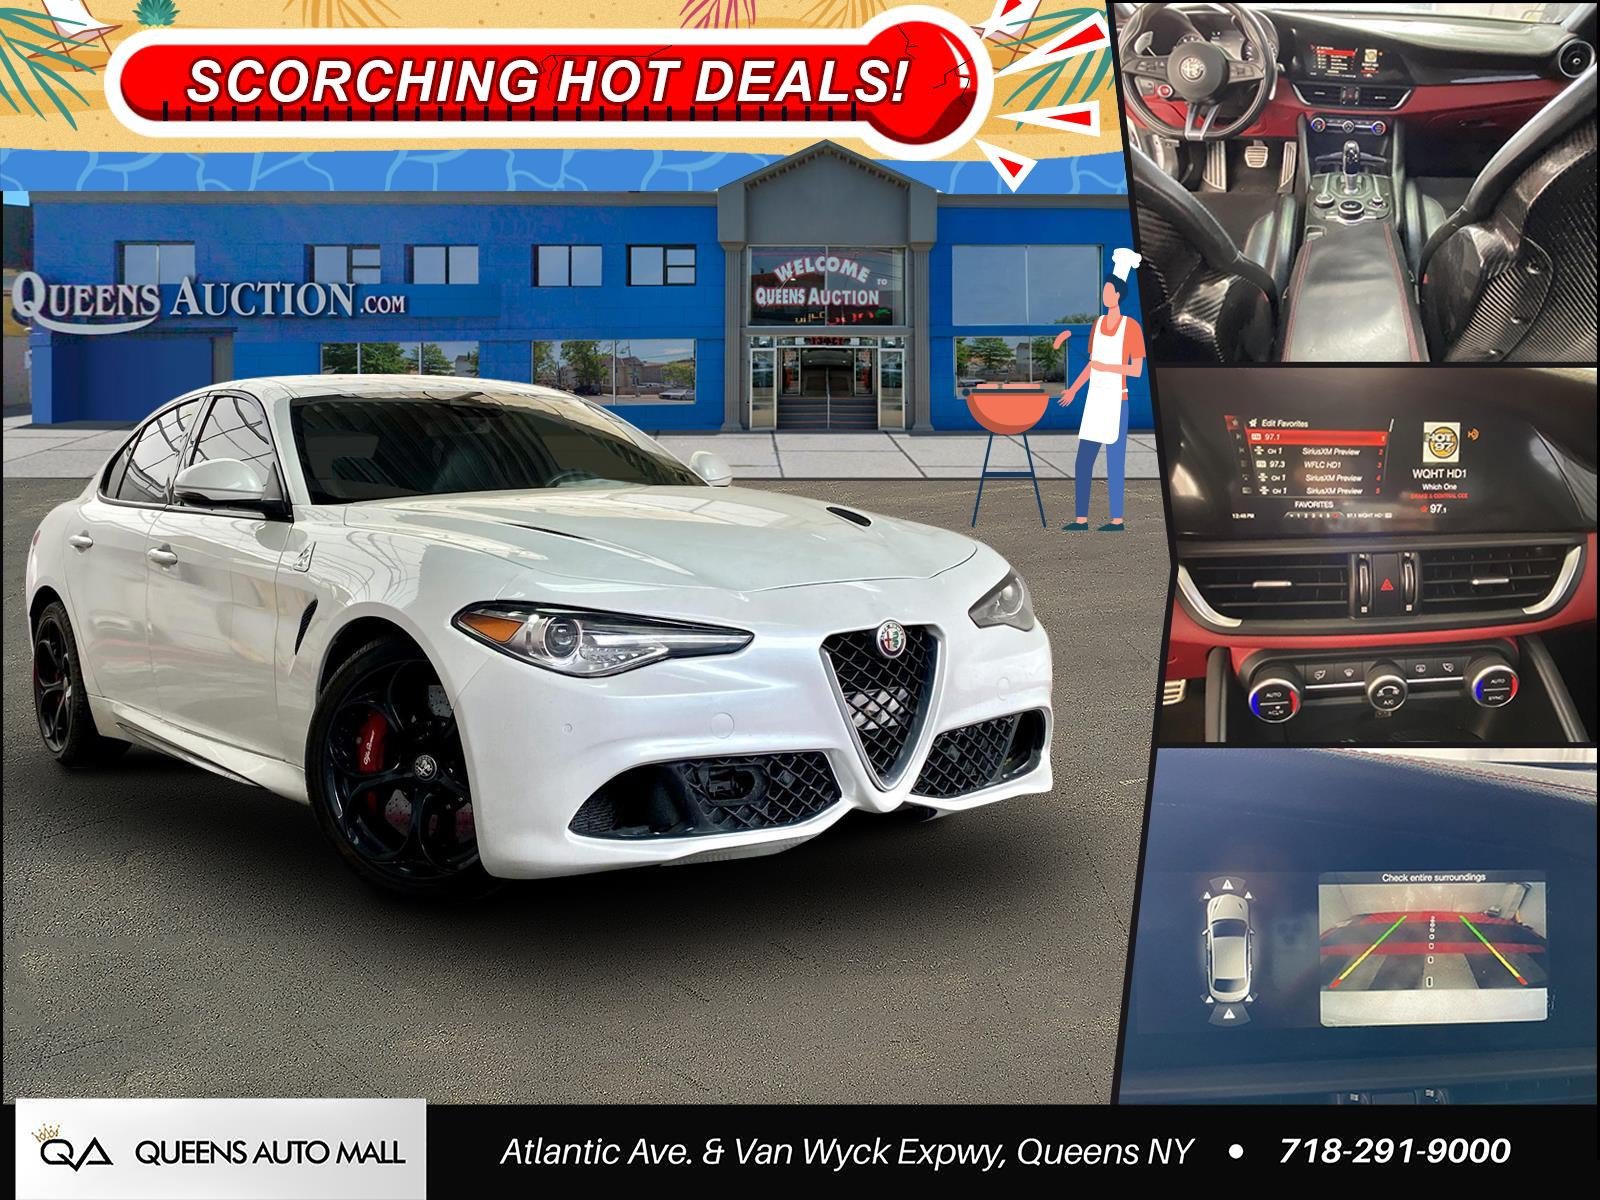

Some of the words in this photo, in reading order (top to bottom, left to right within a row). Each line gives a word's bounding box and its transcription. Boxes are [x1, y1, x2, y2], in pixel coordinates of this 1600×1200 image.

[774, 255, 872, 285] WELCOME
[755, 287, 806, 306] QUEENS
[807, 287, 880, 306] AUCTION
[12, 271, 161, 335] QUEENS
[1261, 419, 1276, 428] Edit
[1277, 419, 1309, 428] Favorites
[1264, 433, 1281, 441] 97.1
[1302, 447, 1333, 456] SiriusXM
[1333, 447, 1361, 456] Preview
[1269, 460, 1286, 468] 97.3
[1304, 461, 1326, 469] WFLC
[1326, 461, 1342, 469] HD1
[1412, 468, 1445, 479] WQHT
[1446, 468, 1467, 479] HD1
[1305, 474, 1336, 483] SiriusXM
[1336, 474, 1363, 483] Preview
[1422, 482, 1442, 491] Which
[1443, 483, 1457, 491] One
[1306, 487, 1337, 495] SiriusXM
[1336, 487, 1363, 496] Preview
[1294, 500, 1335, 509] FAVORITES
[1382, 873, 1408, 882] Check
[1409, 873, 1433, 882] entire
[1434, 872, 1487, 883] surroundings
